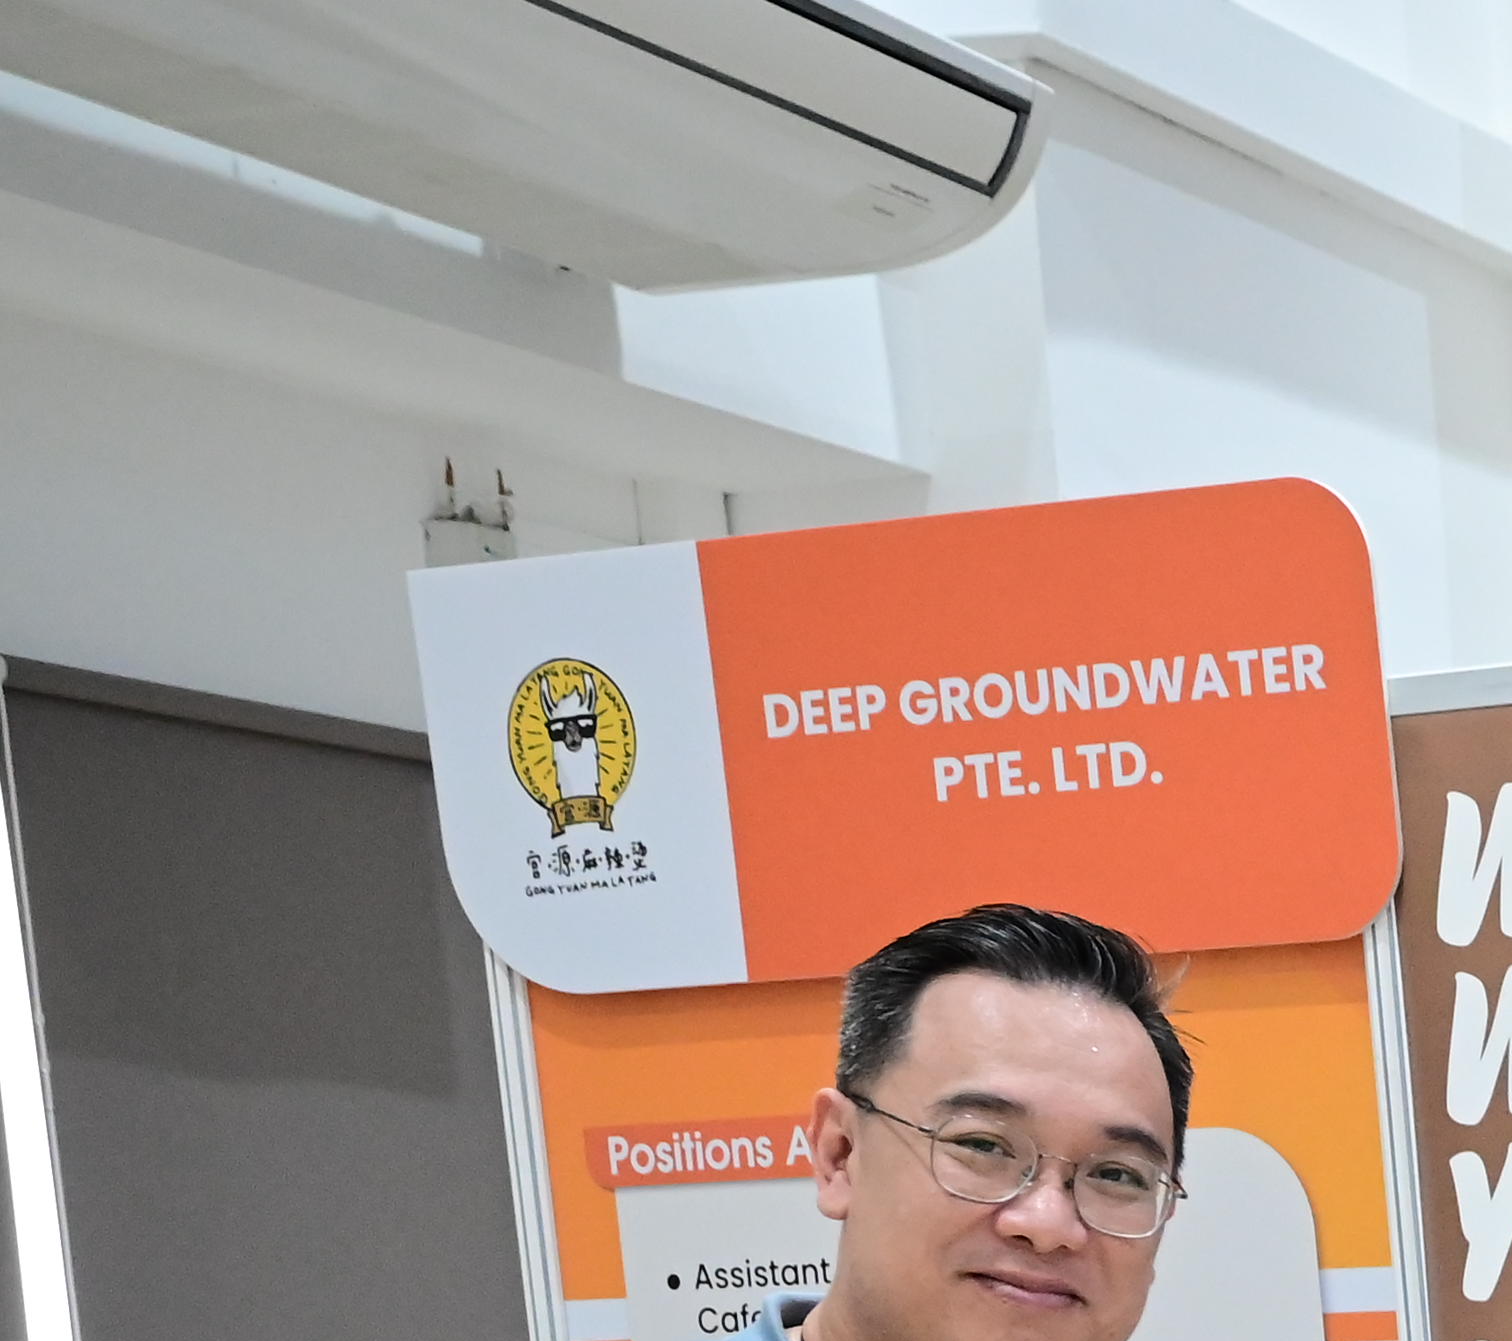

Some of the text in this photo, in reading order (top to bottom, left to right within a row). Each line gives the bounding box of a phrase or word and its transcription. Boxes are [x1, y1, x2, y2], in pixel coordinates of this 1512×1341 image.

[763, 641, 1327, 741] DEEP GROUNDWATER
[931, 739, 1165, 803] PTE. LTD.
[607, 1132, 773, 1175] Positions
[695, 1258, 831, 1290] Assistant
